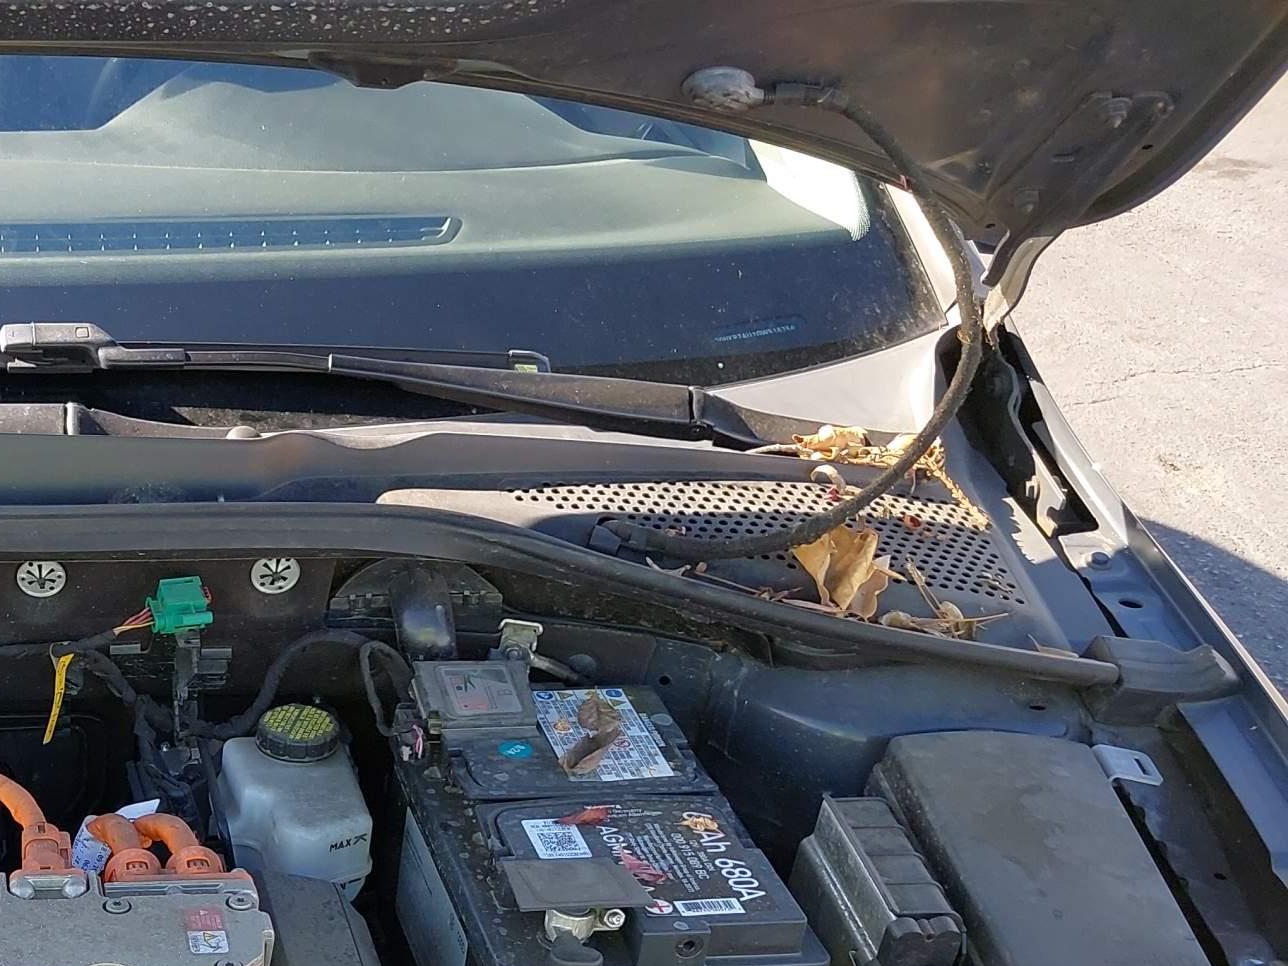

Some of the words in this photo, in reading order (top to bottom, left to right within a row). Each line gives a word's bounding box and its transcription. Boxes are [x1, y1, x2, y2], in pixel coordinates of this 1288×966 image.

[329, 838, 352, 853] MAX
[678, 844, 695, 857] 915
[694, 869, 710, 880] BC
[714, 858, 767, 902] 680A
